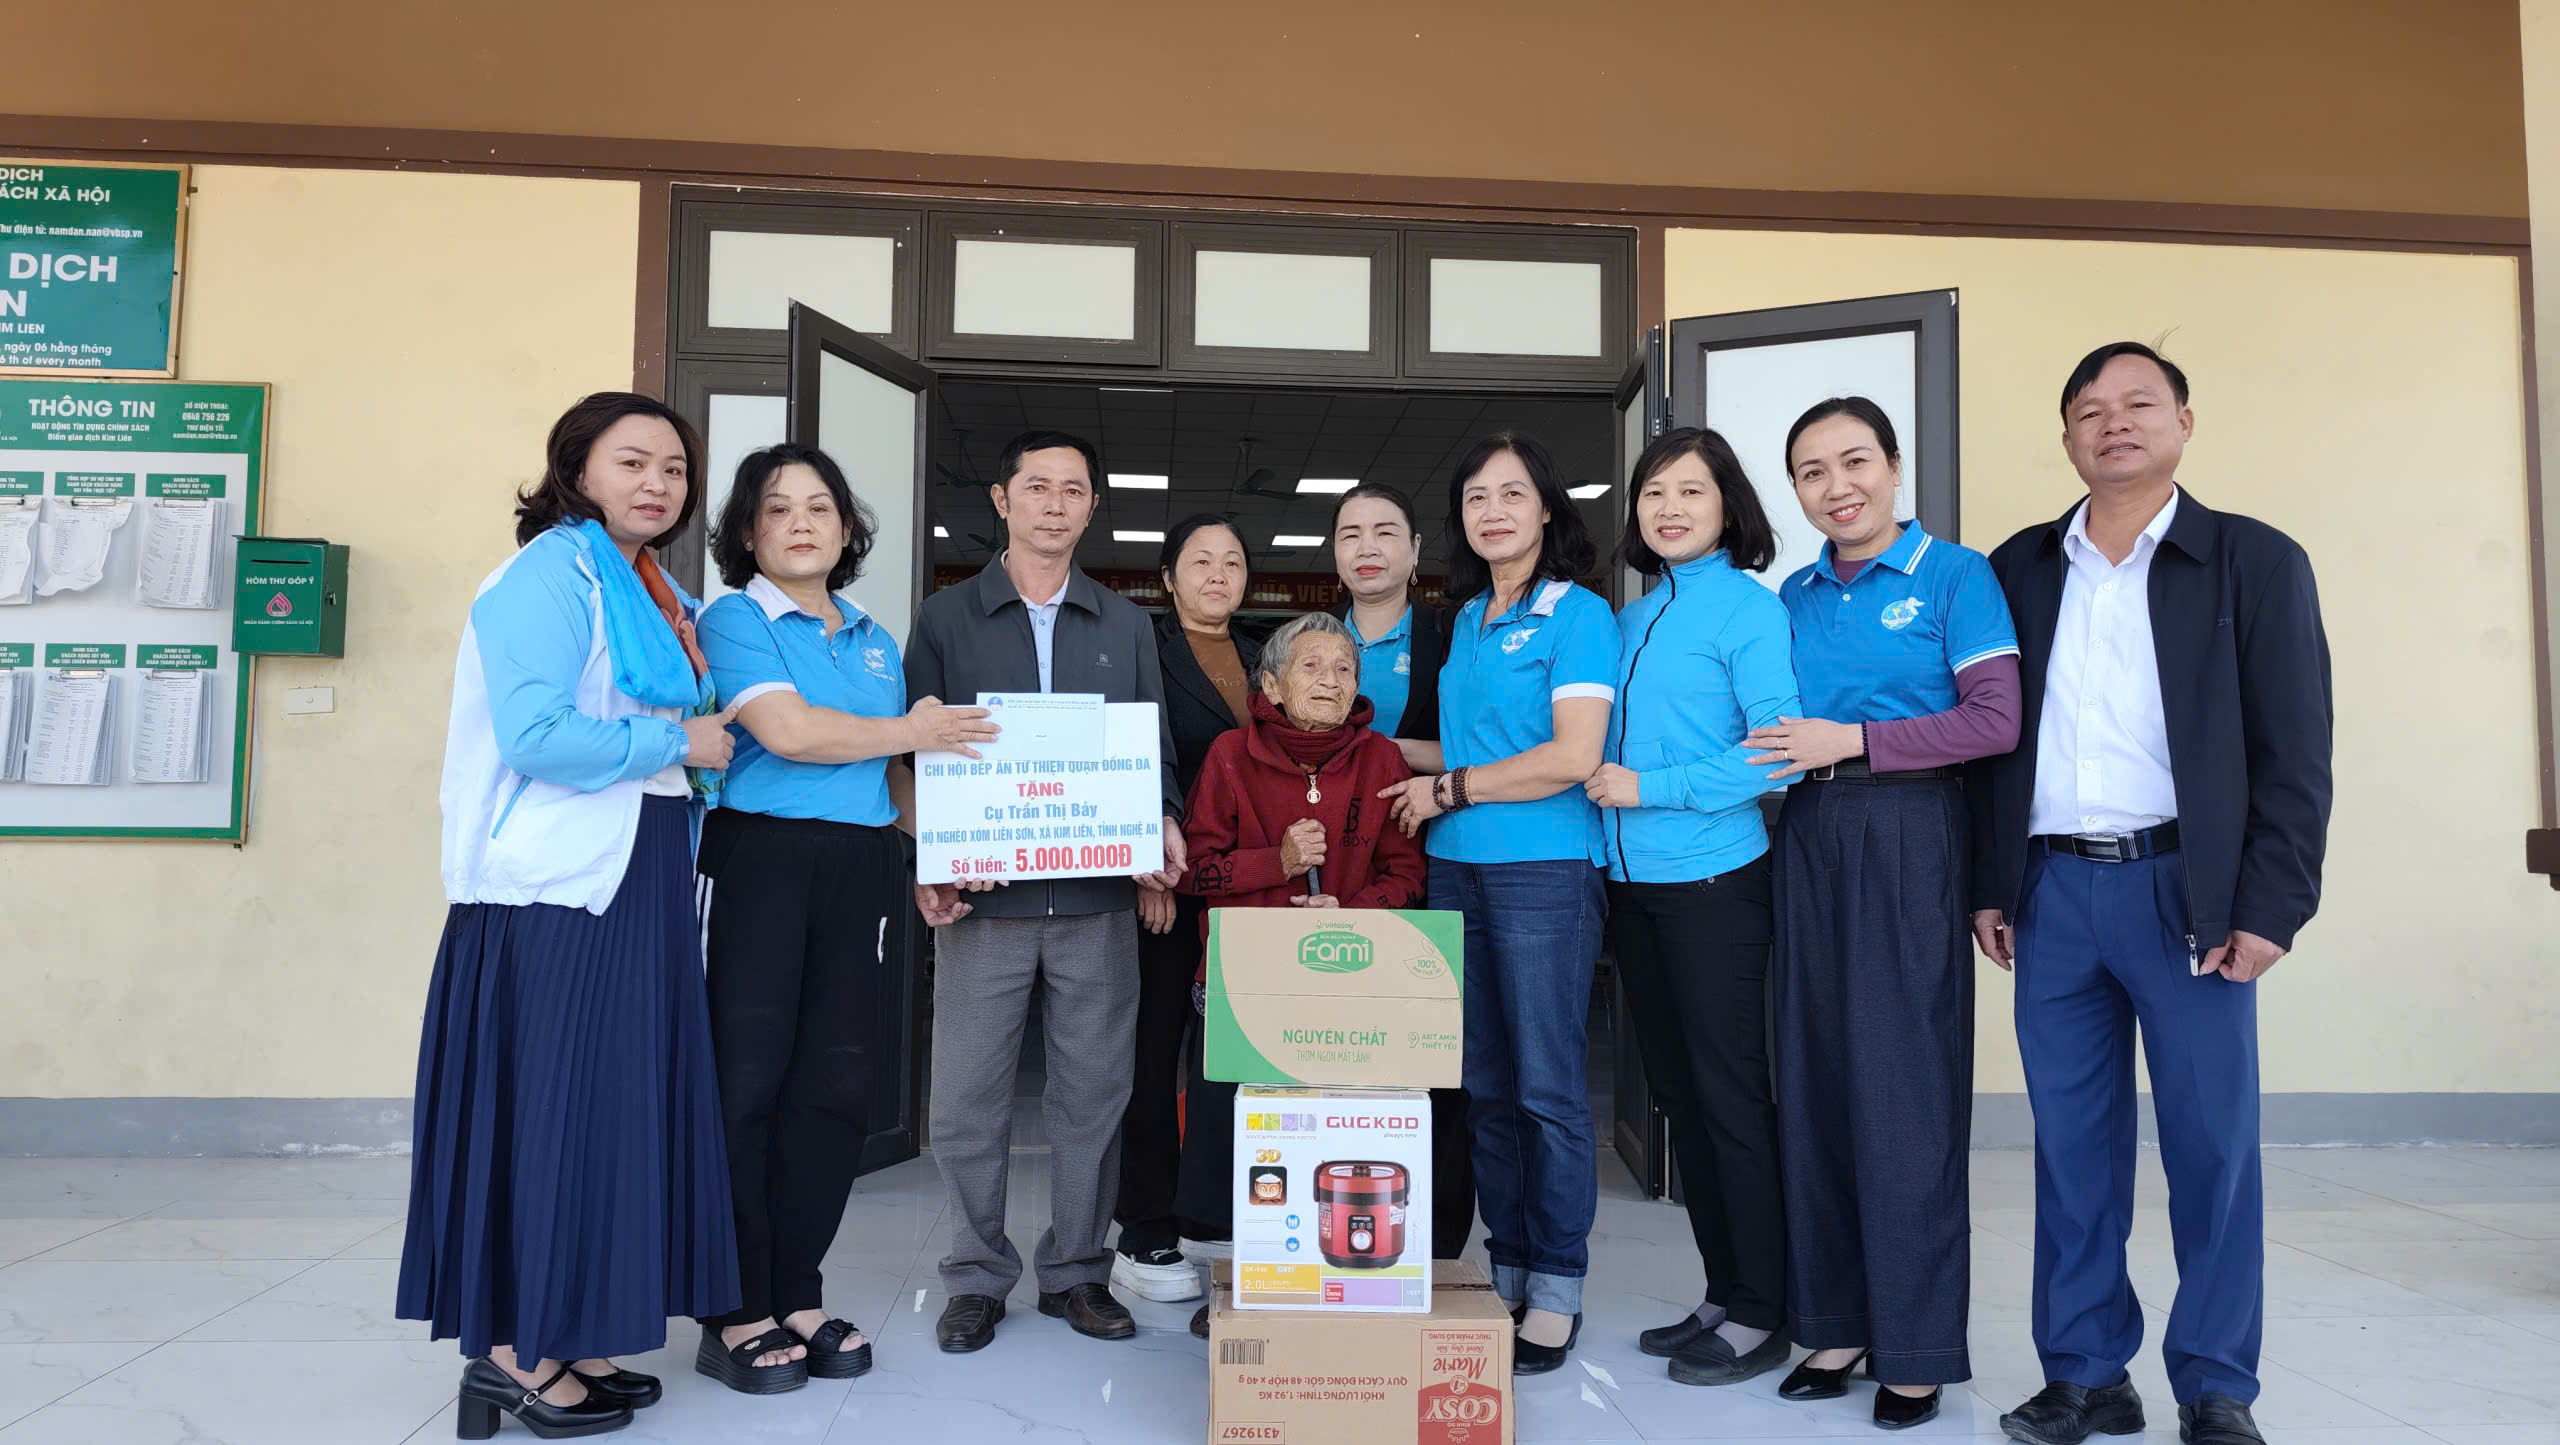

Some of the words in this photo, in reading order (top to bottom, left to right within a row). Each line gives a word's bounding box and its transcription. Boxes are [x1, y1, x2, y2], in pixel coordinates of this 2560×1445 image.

[44, 186, 71, 201] XÃ
[77, 187, 110, 205] HỘI
[14, 224, 33, 235] điện
[49, 226, 143, 238] namdan.nan@vbsp.vn
[9, 252, 118, 288] DỊCH
[18, 323, 45, 334] LIEN
[4, 341, 31, 354] ngày
[34, 343, 47, 352] 06
[50, 340, 78, 355] hằng
[81, 343, 112, 356] tháng
[9, 355, 19, 364] th
[22, 356, 33, 365] of
[35, 357, 65, 367] every
[68, 356, 101, 366] month
[29, 394, 113, 417] THÔNG
[120, 401, 155, 418] TIN
[202, 413, 215, 421] 756
[51, 422, 71, 432] ĐỘNG
[86, 423, 105, 432] DỤNG
[130, 423, 150, 432] SÁCH
[68, 433, 83, 442] giao
[246, 576, 267, 585] HÒM
[269, 577, 287, 585] THƯ
[288, 576, 307, 585] GÓP
[308, 576, 315, 585] Ý
[924, 763, 944, 776] CHI
[947, 761, 966, 779] HỘI
[1102, 755, 1132, 771] ĐỐNG
[1016, 780, 1064, 800] TẶNG
[984, 806, 1003, 823] Cụ
[1008, 802, 1040, 819] Trần
[1044, 804, 1066, 820] Thị
[1071, 801, 1098, 818] Bảy
[921, 829, 934, 846] HỘ
[970, 827, 991, 842] XÓM
[993, 825, 1013, 841] LIÊN
[1015, 826, 1037, 840] SƠN,
[1039, 824, 1051, 839] XÃ
[1053, 825, 1071, 839] KIM
[1073, 824, 1096, 838] LIÊN,
[1098, 820, 1118, 837] TỈNH
[1120, 821, 1143, 838] NGHỆ
[1146, 823, 1158, 835] AN
[951, 856, 970, 874] Số
[974, 855, 1007, 873] tiền:
[1015, 844, 1132, 873] 5.000.000Đ
[1417, 959, 1437, 969] 100%
[1282, 1027, 1344, 1045] NGUYÊN
[1349, 1024, 1387, 1046] CHẤT
[1422, 1040, 1442, 1049] THIẾT
[1296, 1050, 1315, 1062] THƠM
[1317, 1050, 1336, 1062] NGON
[1255, 1149, 1281, 1163] 3D
[1433, 1357, 1487, 1380] Marie
[1239, 1374, 1245, 1383] g
[1246, 1376, 1258, 1385] 40
[1268, 1375, 1289, 1388] HỘP
[1290, 1376, 1302, 1385] 48
[1304, 1376, 1325, 1388] GÓI:
[1327, 1377, 1356, 1388] ĐÓNG
[1358, 1377, 1384, 1388] CÁCH
[1387, 1376, 1408, 1386] QUY
[1259, 1391, 1272, 1400] KG
[1275, 1391, 1293, 1399] 1,92
[1296, 1389, 1323, 1400] TỊNH:
[1324, 1389, 1358, 1400] LƯỢNG
[1361, 1392, 1384, 1404] KHỐI
[1420, 1395, 1500, 1426] COSY
[1222, 1427, 1280, 1439] 4319267
